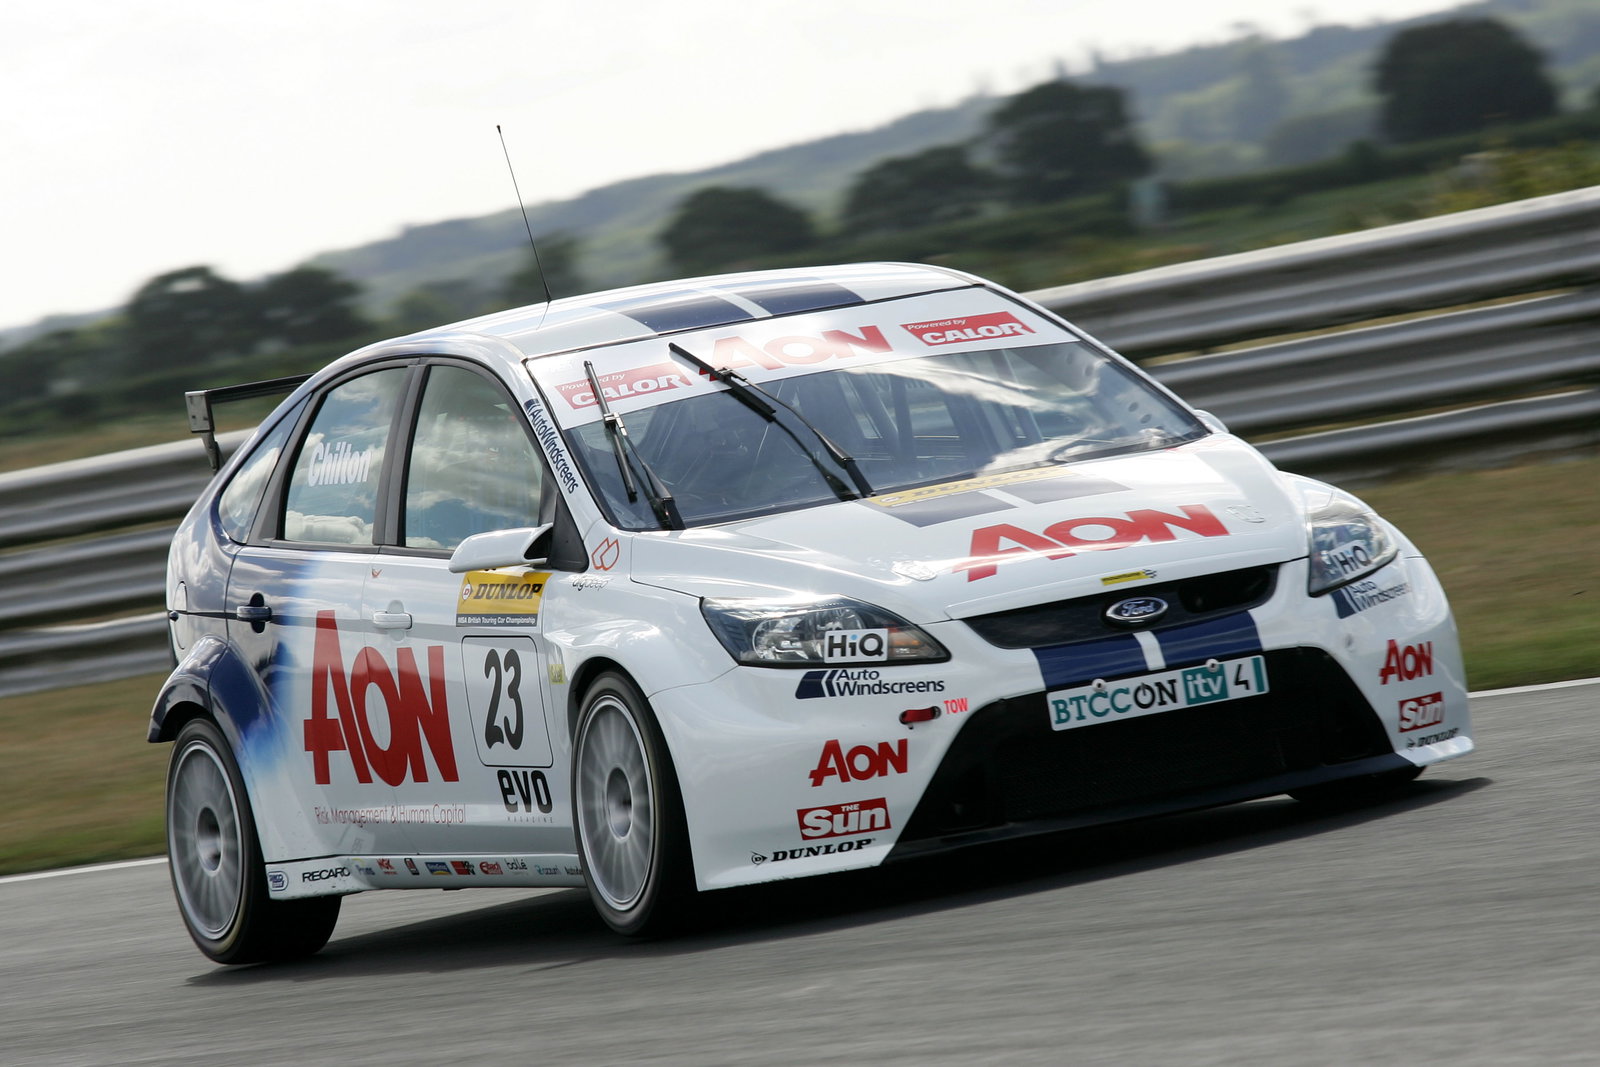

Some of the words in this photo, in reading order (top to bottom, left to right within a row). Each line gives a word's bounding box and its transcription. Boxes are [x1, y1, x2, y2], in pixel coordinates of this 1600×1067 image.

[907, 320, 952, 331] Powered
[922, 323, 1029, 344] CALOR
[699, 325, 893, 382] AON
[612, 373, 625, 381] by
[572, 374, 687, 406] CALOR
[307, 441, 372, 487] Chilton
[951, 503, 1230, 582] AON
[1334, 545, 1372, 574] HiQ
[473, 583, 546, 600] DUNLOP
[1350, 581, 1377, 594] Auto
[468, 616, 481, 624] British
[482, 616, 498, 625] Touring
[506, 617, 536, 625] Championship
[1121, 600, 1155, 617] Ford
[826, 632, 884, 657] HiQ
[1378, 639, 1433, 685] AON
[836, 669, 880, 681] Auto
[1186, 672, 1223, 699] itv
[1234, 663, 1250, 690] 4
[304, 610, 459, 787] AON
[483, 648, 524, 751] 23
[836, 680, 945, 696] Windscreens
[944, 697, 968, 714] TOW
[1401, 700, 1445, 729] Sun
[809, 739, 908, 787] AON
[497, 769, 553, 814] evo
[315, 806, 330, 824] Risk
[331, 805, 388, 828] Management
[391, 805, 398, 824] &
[400, 805, 430, 823] Human
[432, 803, 466, 826] Capital
[841, 803, 860, 812] THE
[801, 807, 886, 837] Sun
[770, 839, 873, 862] DUNLOP
[302, 866, 351, 882] RECARO
